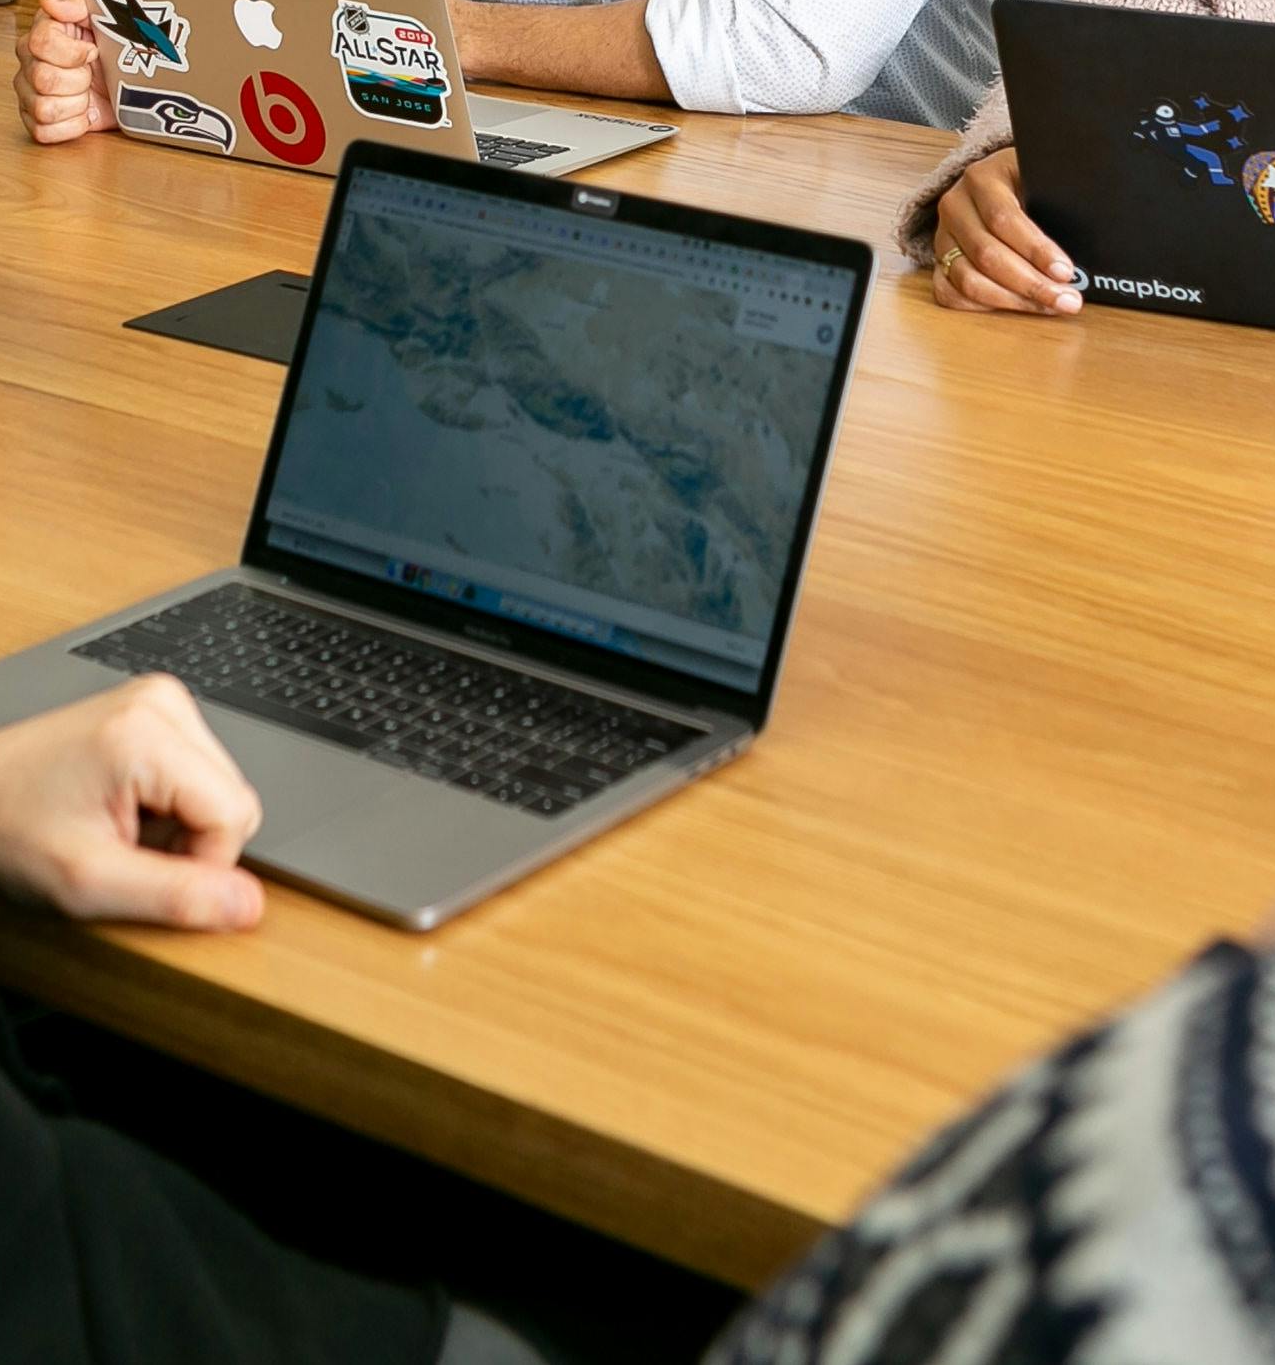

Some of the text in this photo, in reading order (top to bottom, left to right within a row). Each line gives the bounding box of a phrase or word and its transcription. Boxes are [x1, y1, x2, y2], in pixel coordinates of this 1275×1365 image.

[397, 30, 431, 43] 2019
[360, 92, 433, 113] SAN JOSE
[1093, 274, 1203, 304] mapbox
